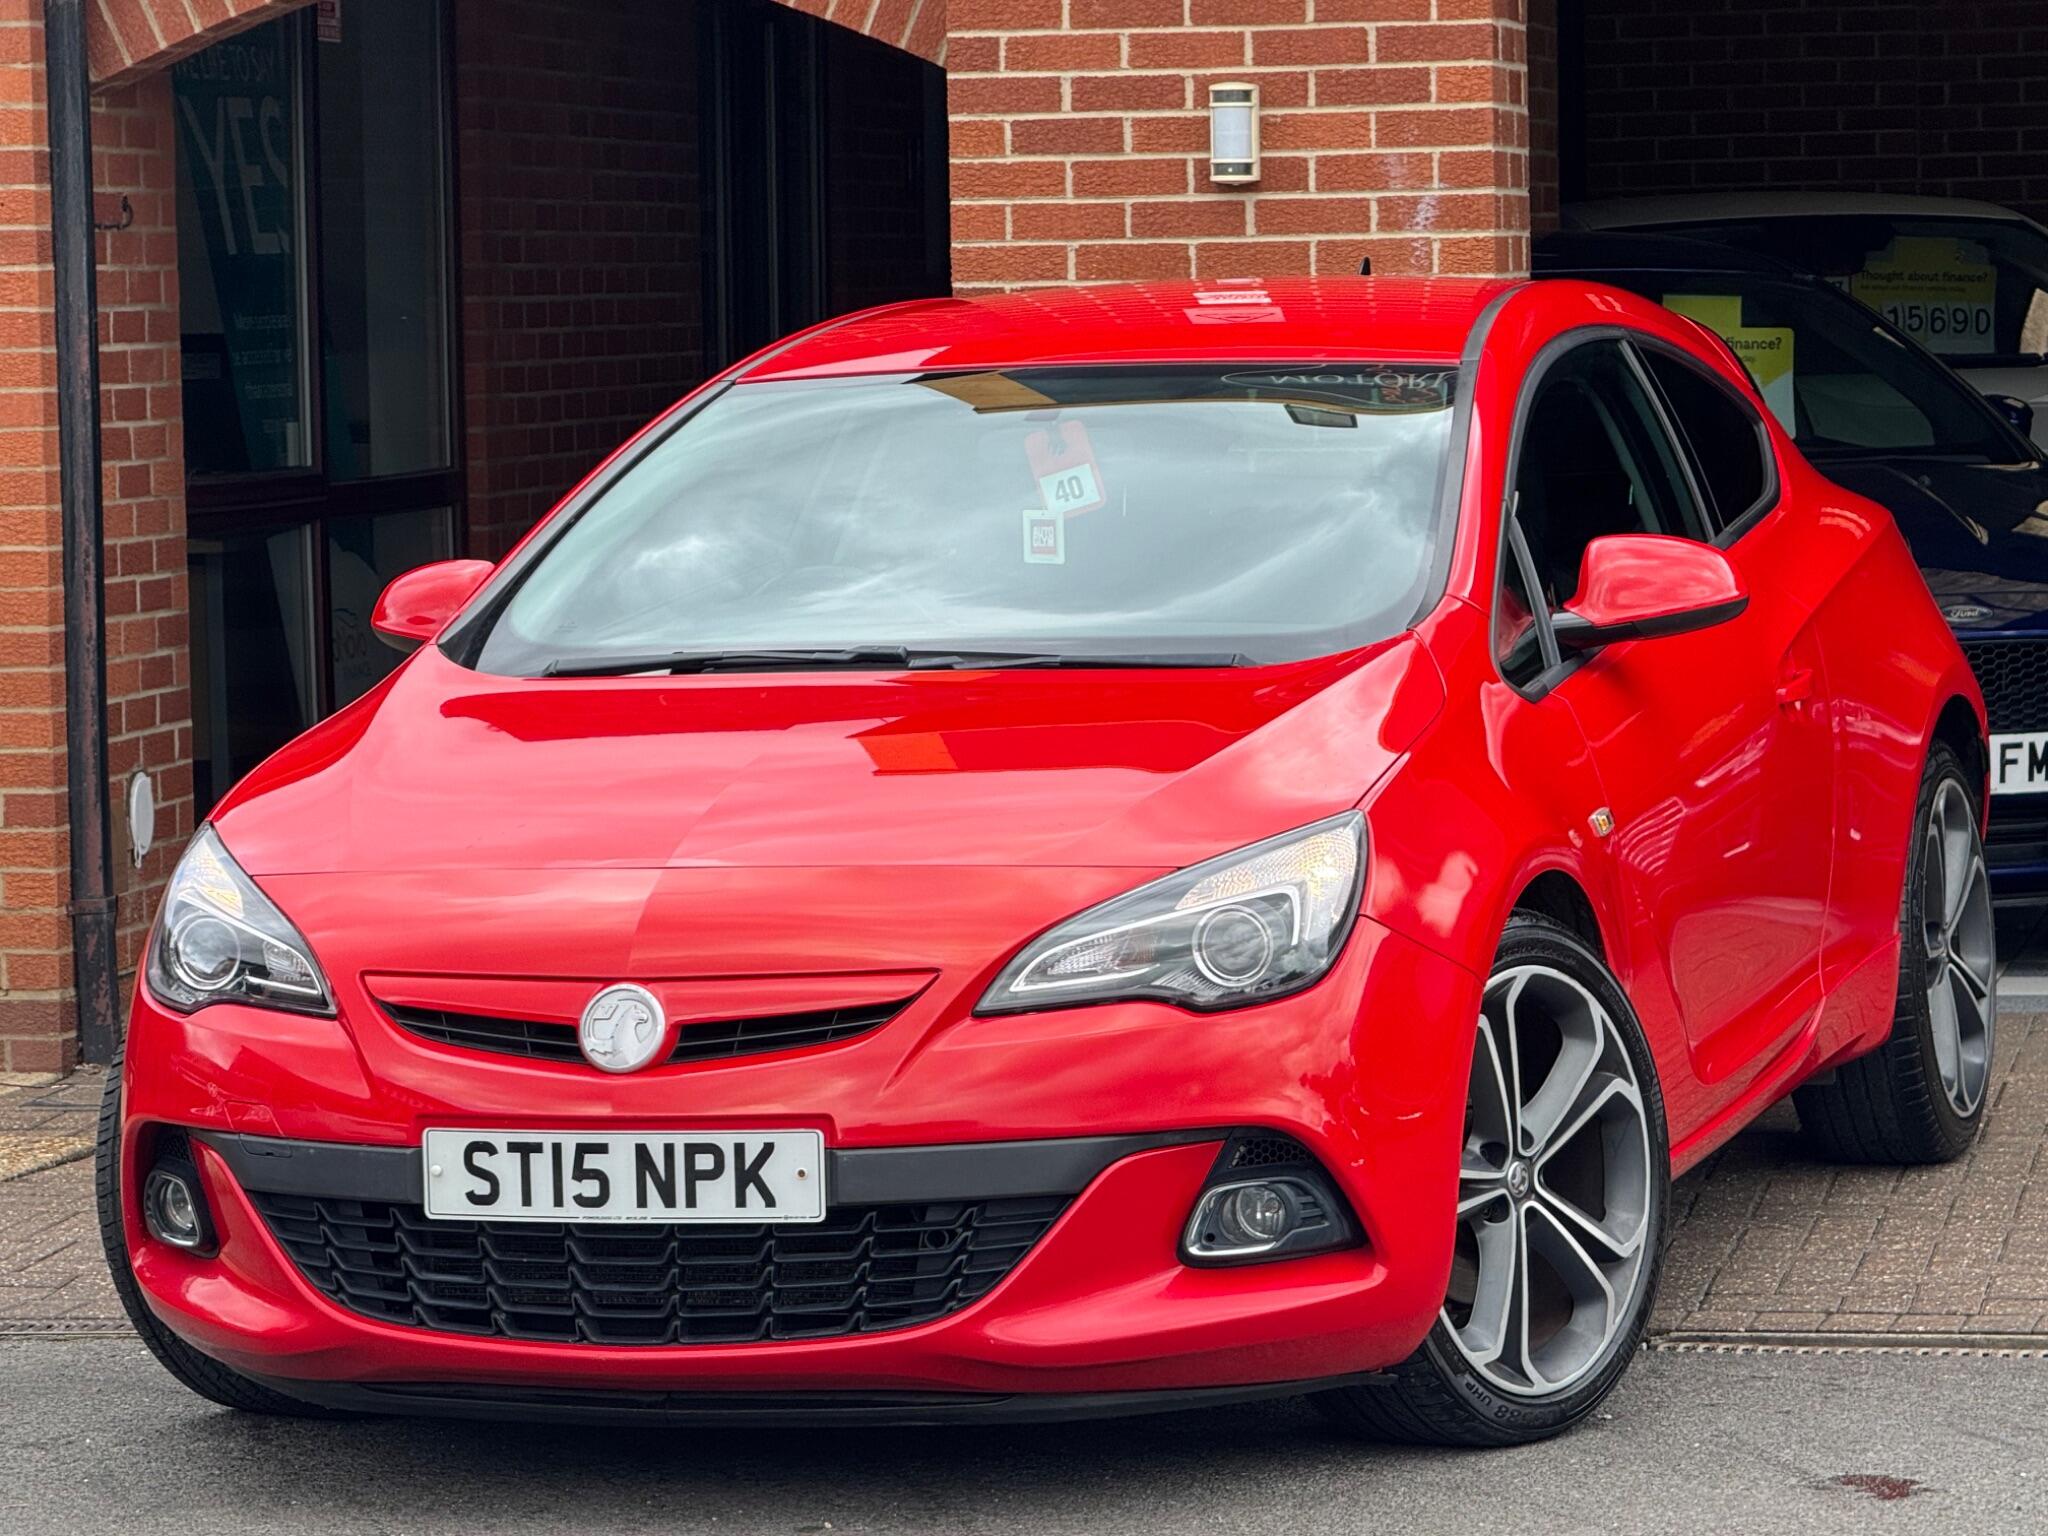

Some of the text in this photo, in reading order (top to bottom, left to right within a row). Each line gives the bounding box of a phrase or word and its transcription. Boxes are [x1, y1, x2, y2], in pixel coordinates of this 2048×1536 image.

[178, 95, 290, 255] YES
[1861, 271, 1988, 283] Thought about finance?
[1887, 305, 1991, 335] 15690
[1055, 475, 1084, 502] 40
[1950, 607, 1980, 618] Ford
[1999, 740, 2048, 784] FM
[463, 1140, 777, 1209] ST15 NPK
[1464, 1380, 1493, 1407] UHP
